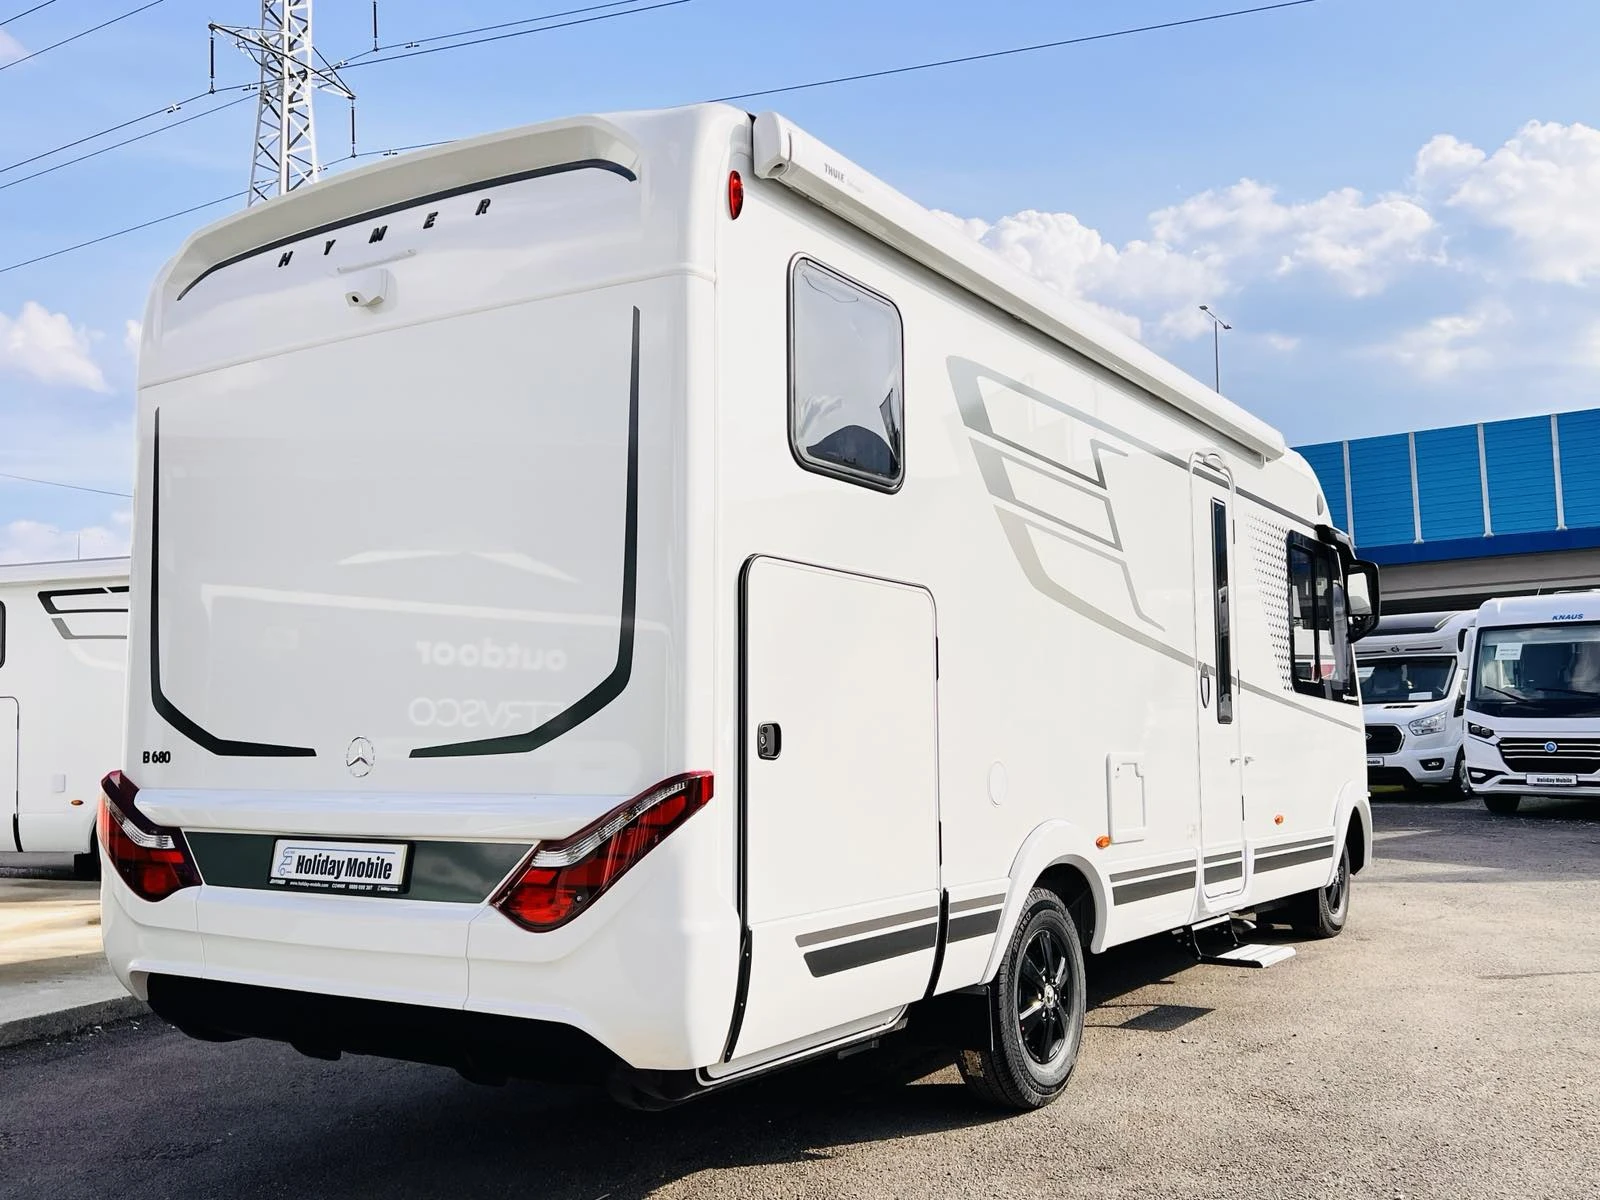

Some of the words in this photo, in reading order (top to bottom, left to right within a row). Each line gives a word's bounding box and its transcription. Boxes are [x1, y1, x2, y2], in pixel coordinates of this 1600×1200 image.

[824, 162, 845, 183] THULE
[278, 198, 491, 268] HYMER
[1552, 613, 1584, 621] KNAUS
[142, 750, 150, 764] B
[151, 750, 171, 764] 680
[295, 853, 345, 879] Holiday
[344, 856, 393, 880] Mobile
